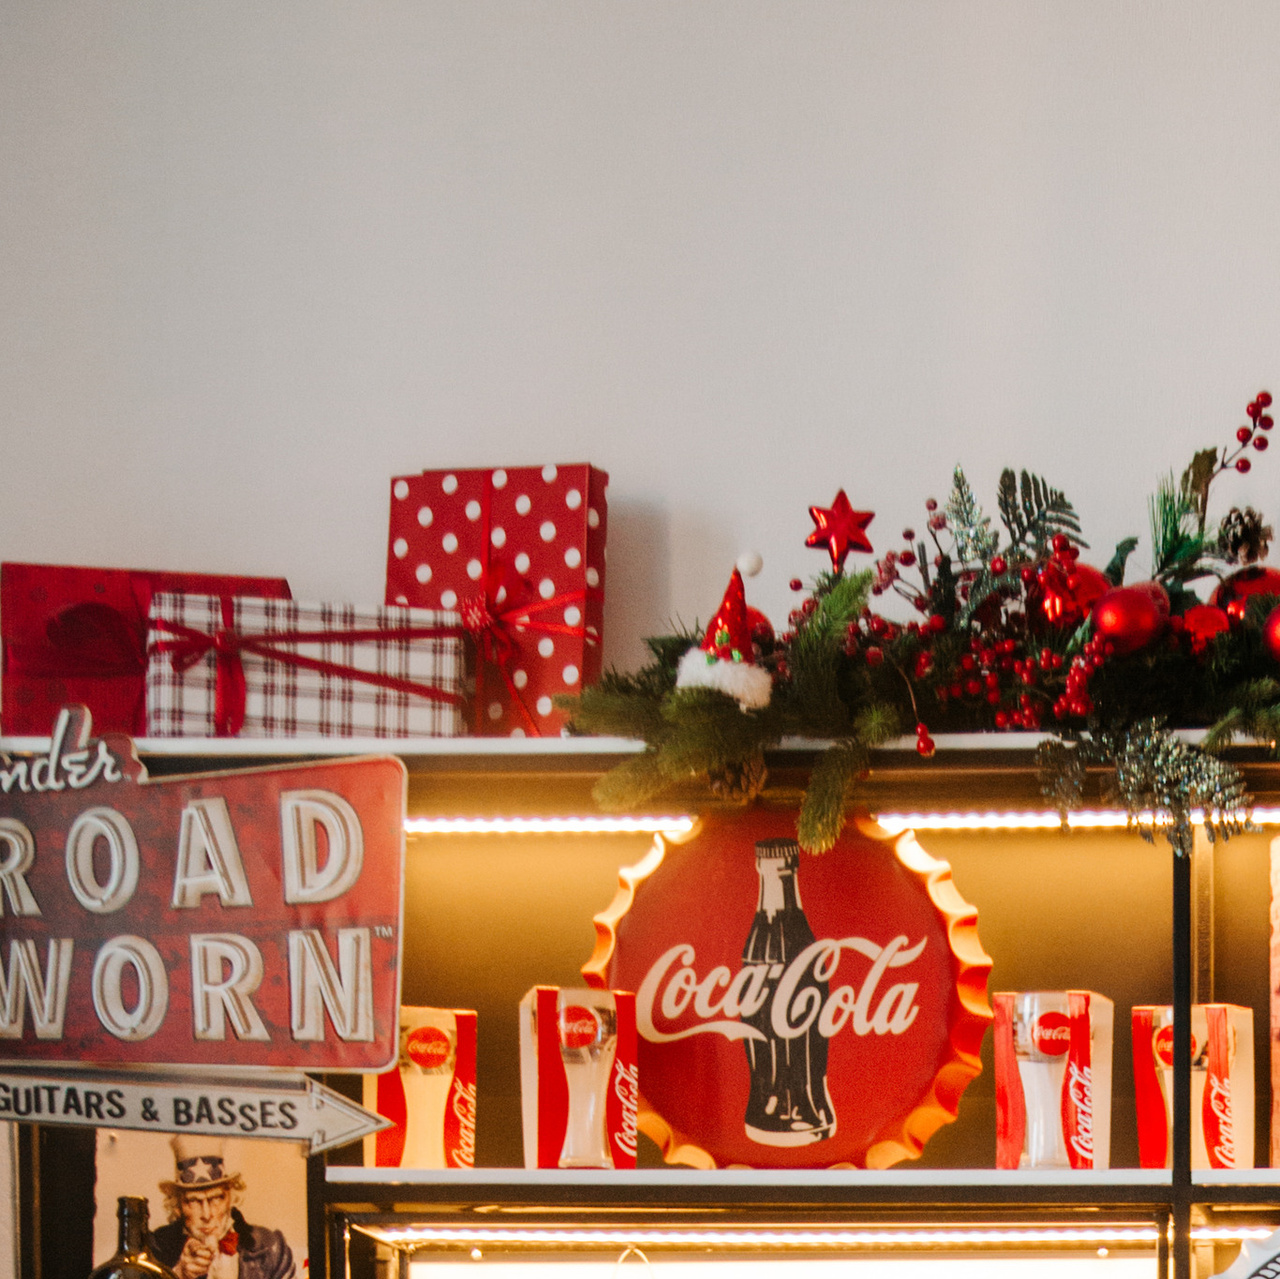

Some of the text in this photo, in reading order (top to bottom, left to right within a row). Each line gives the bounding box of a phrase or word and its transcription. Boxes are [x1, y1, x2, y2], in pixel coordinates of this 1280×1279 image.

[0, 926, 376, 1042] WORN
[637, 934, 928, 1044] Coca-Cola
[140, 1097, 160, 1122] &
[172, 1096, 299, 1131] BASSES
